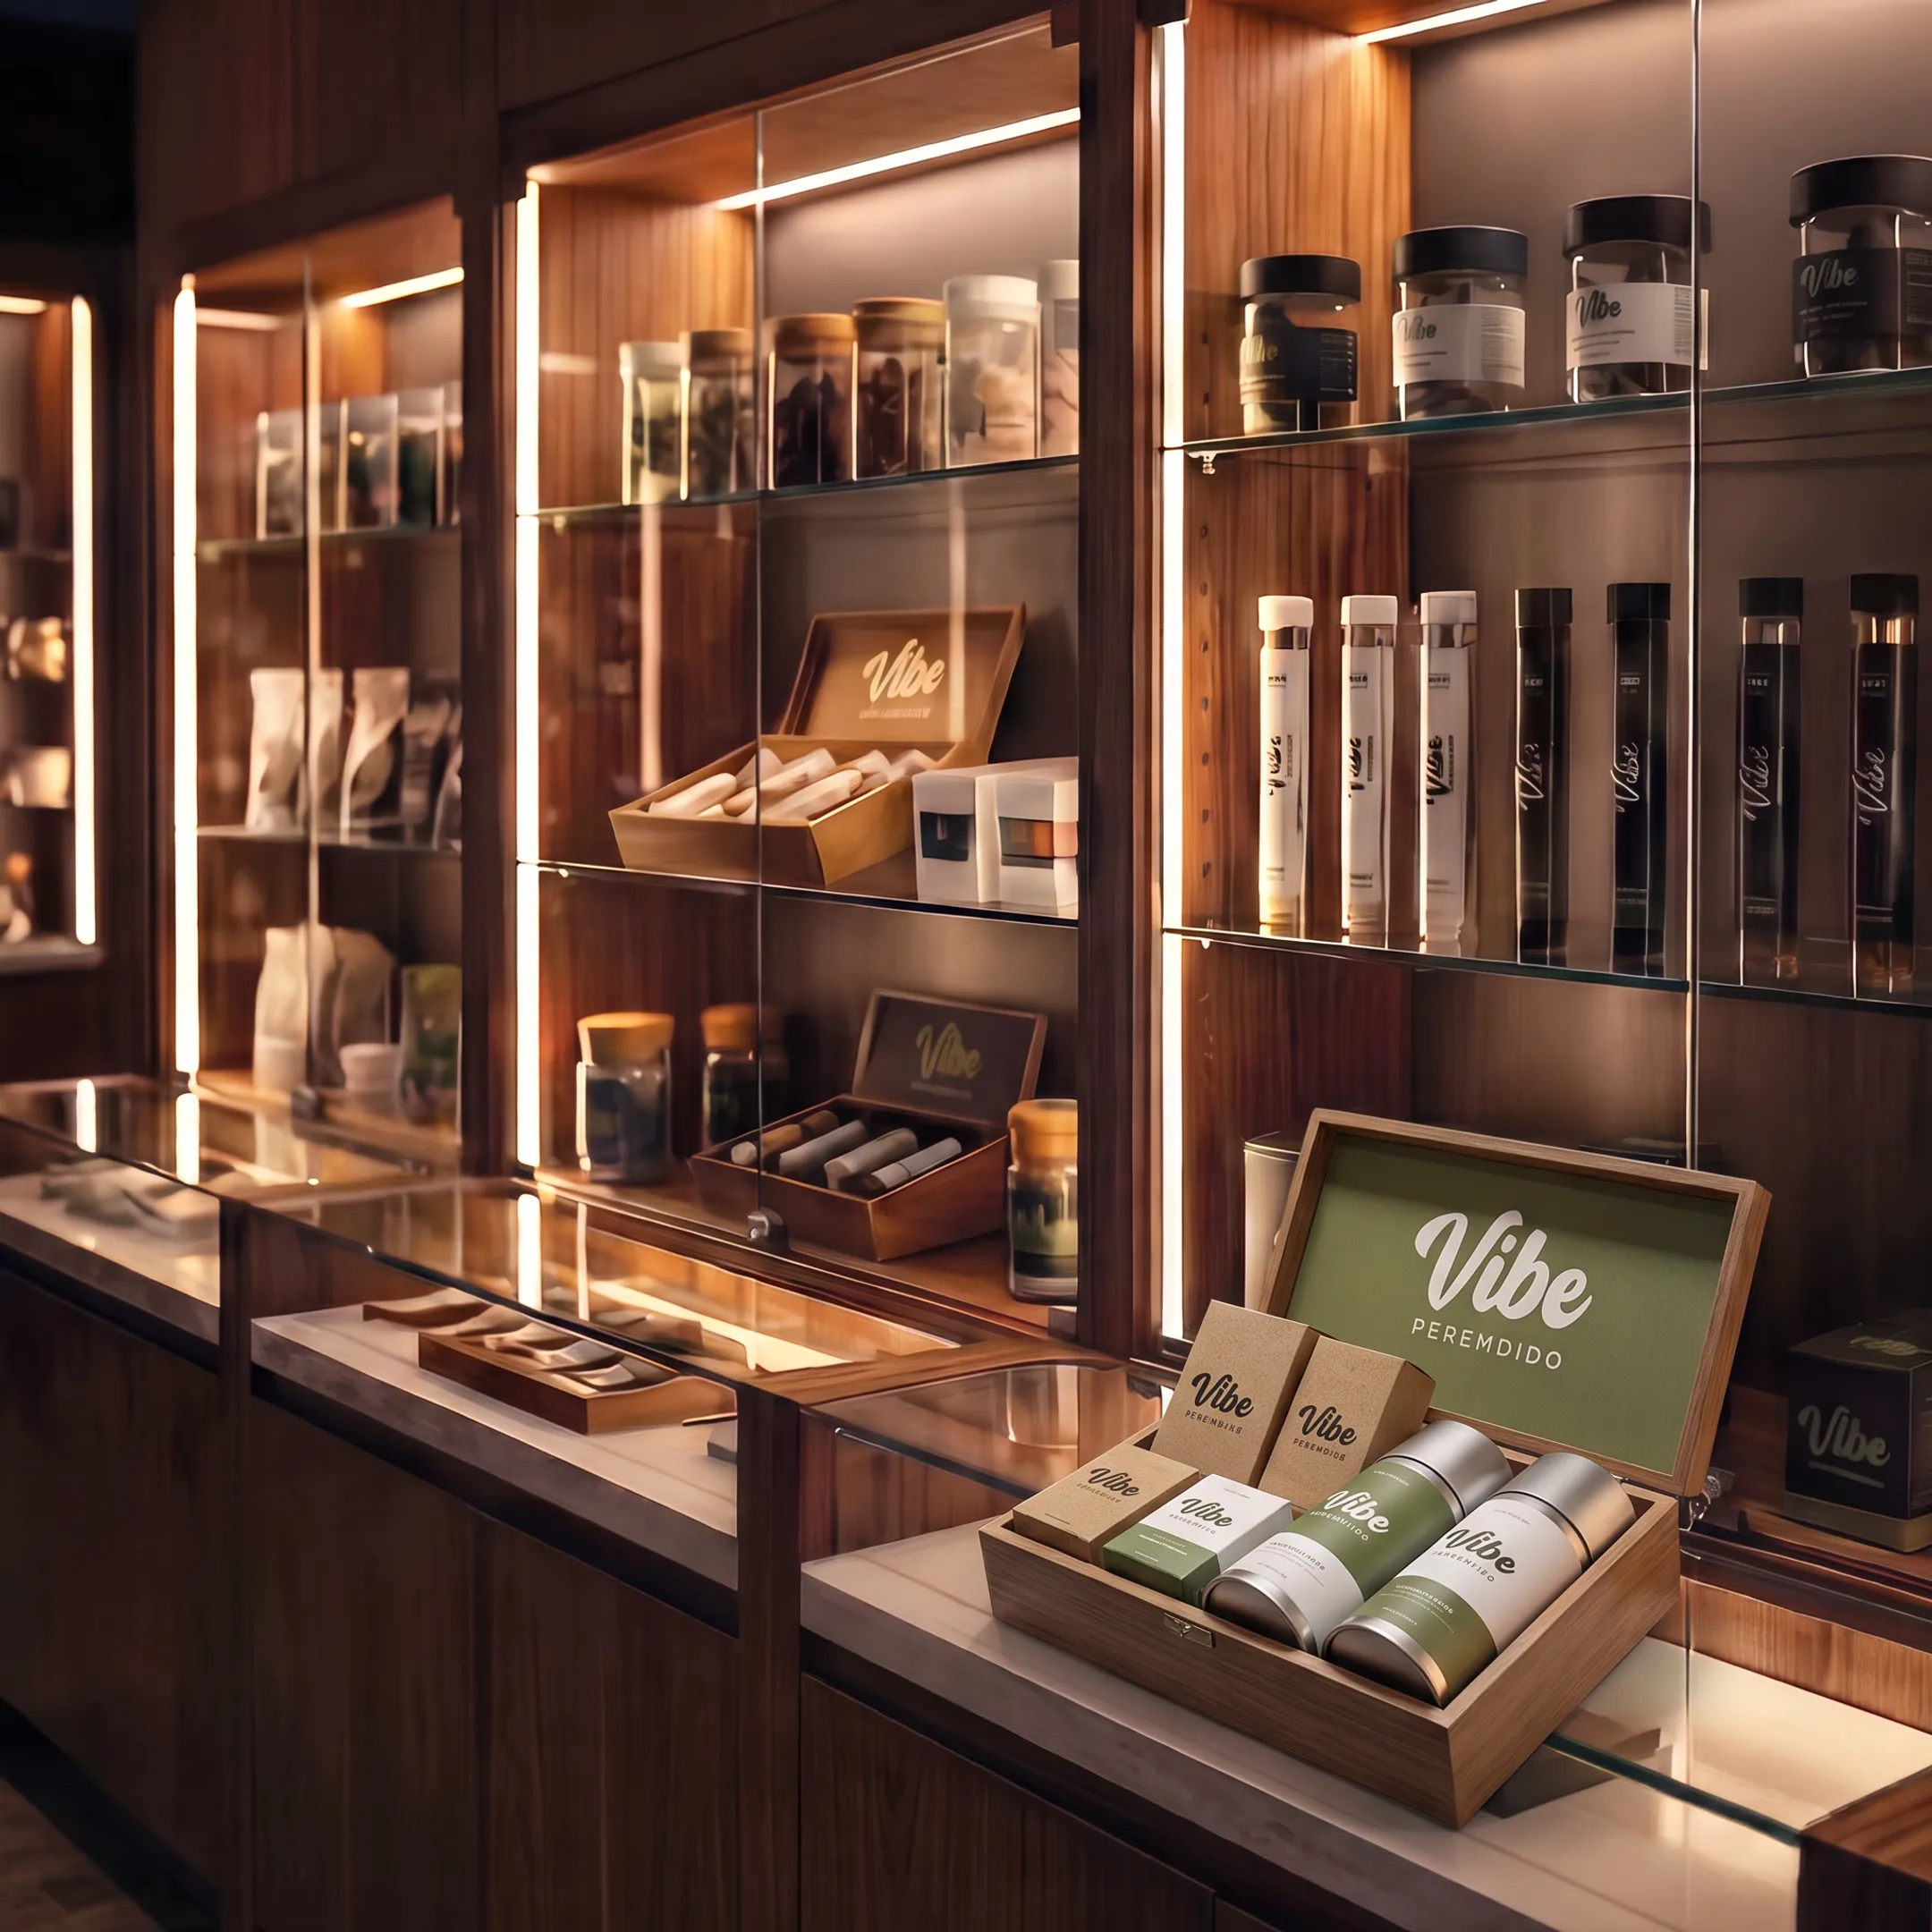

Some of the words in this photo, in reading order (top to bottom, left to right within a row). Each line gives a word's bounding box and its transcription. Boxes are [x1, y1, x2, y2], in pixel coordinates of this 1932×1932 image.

[1801, 258, 1858, 298] Vibe
[1575, 290, 1623, 327] Vibe
[862, 638, 945, 703] Vibe
[916, 1021, 983, 1080] Vibe
[1414, 1209, 1593, 1330] Vibe
[1411, 1318, 1563, 1370] PEREMDIDO
[1191, 1372, 1254, 1418] Vibe
[1298, 1404, 1358, 1445] Vibe
[1797, 1405, 1891, 1467] Vibe
[1089, 1468, 1140, 1496] Vibe
[1181, 1498, 1233, 1527] Vibe
[1324, 1490, 1389, 1533] Vibe
[1445, 1529, 1515, 1574] Vibe
